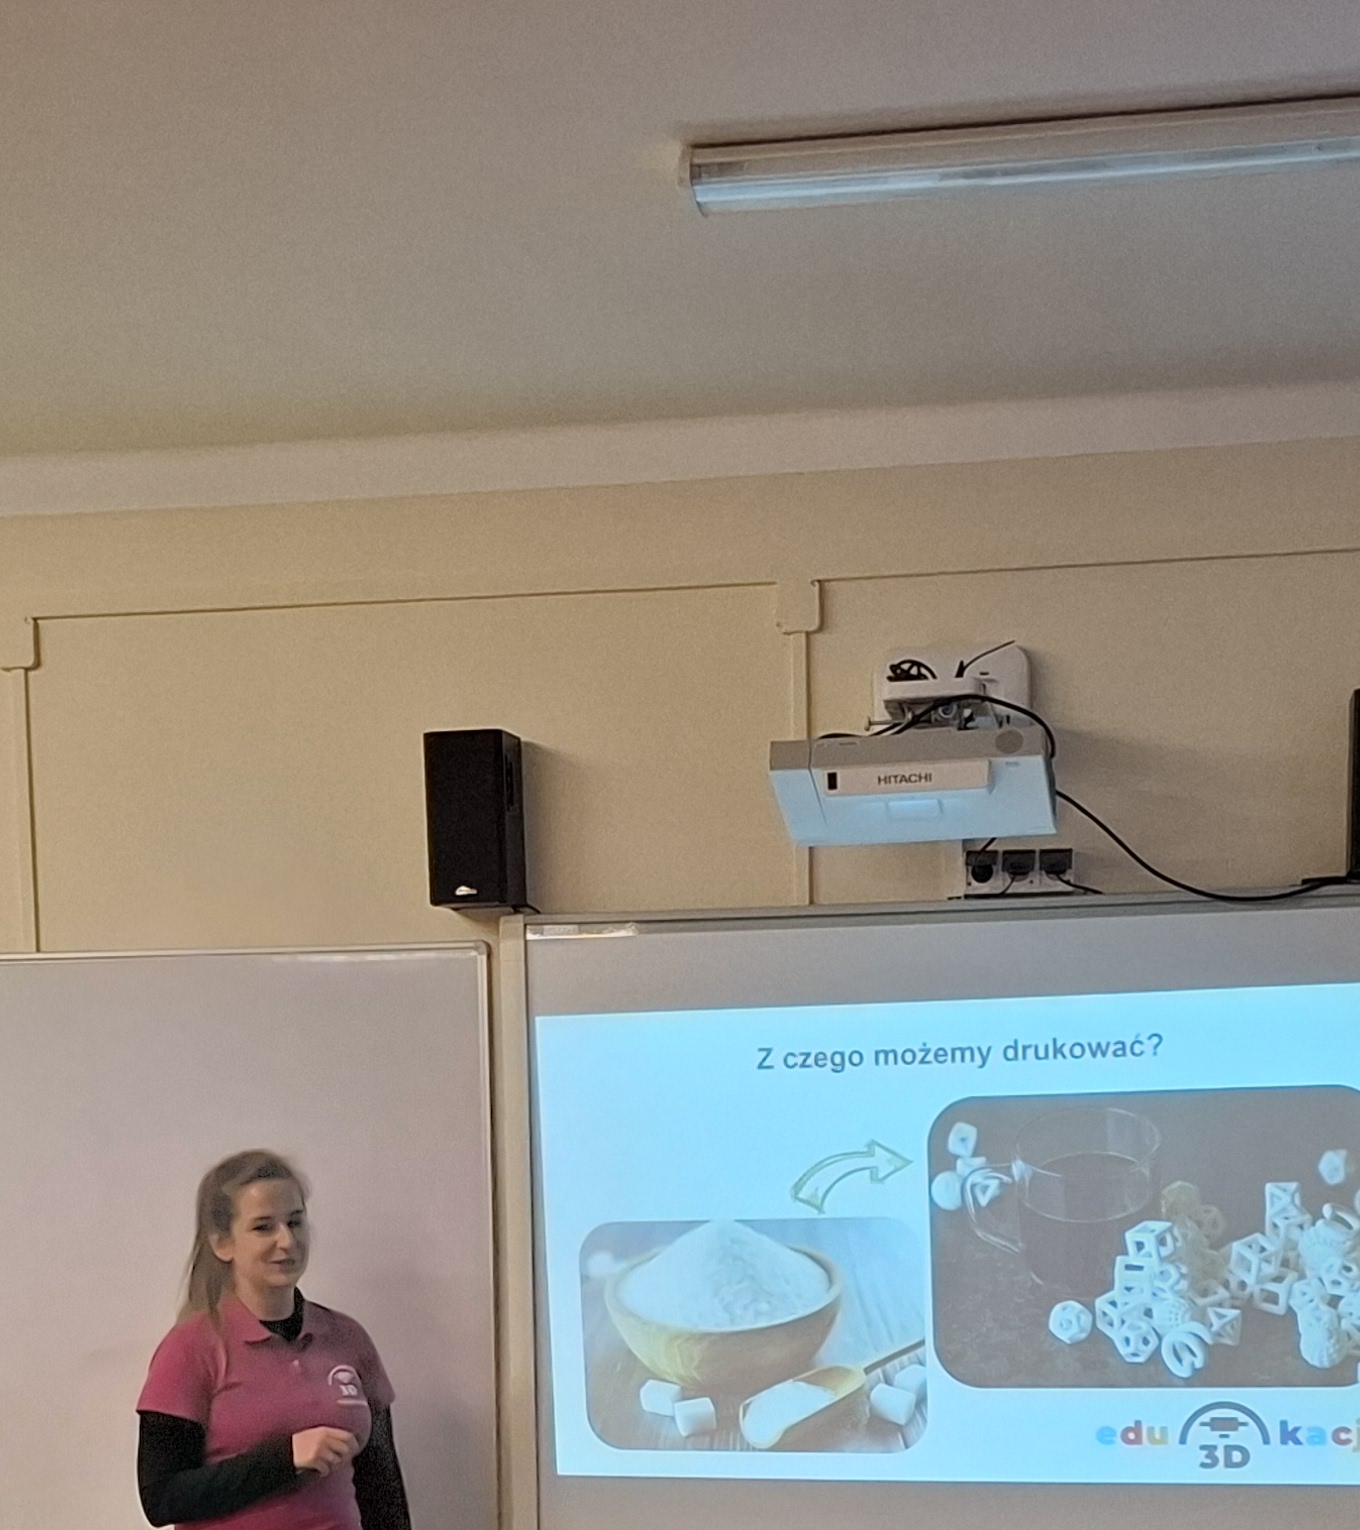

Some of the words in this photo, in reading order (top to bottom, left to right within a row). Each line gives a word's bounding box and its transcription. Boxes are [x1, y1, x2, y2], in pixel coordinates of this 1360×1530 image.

[877, 772, 933, 786] HITACHI
[756, 1047, 775, 1070] Z
[782, 1047, 865, 1073] czego
[873, 1041, 993, 1069] możemy
[1002, 1032, 1164, 1062] drukować?
[1095, 1419, 1170, 1446] edu
[1198, 1444, 1252, 1470] 3D
